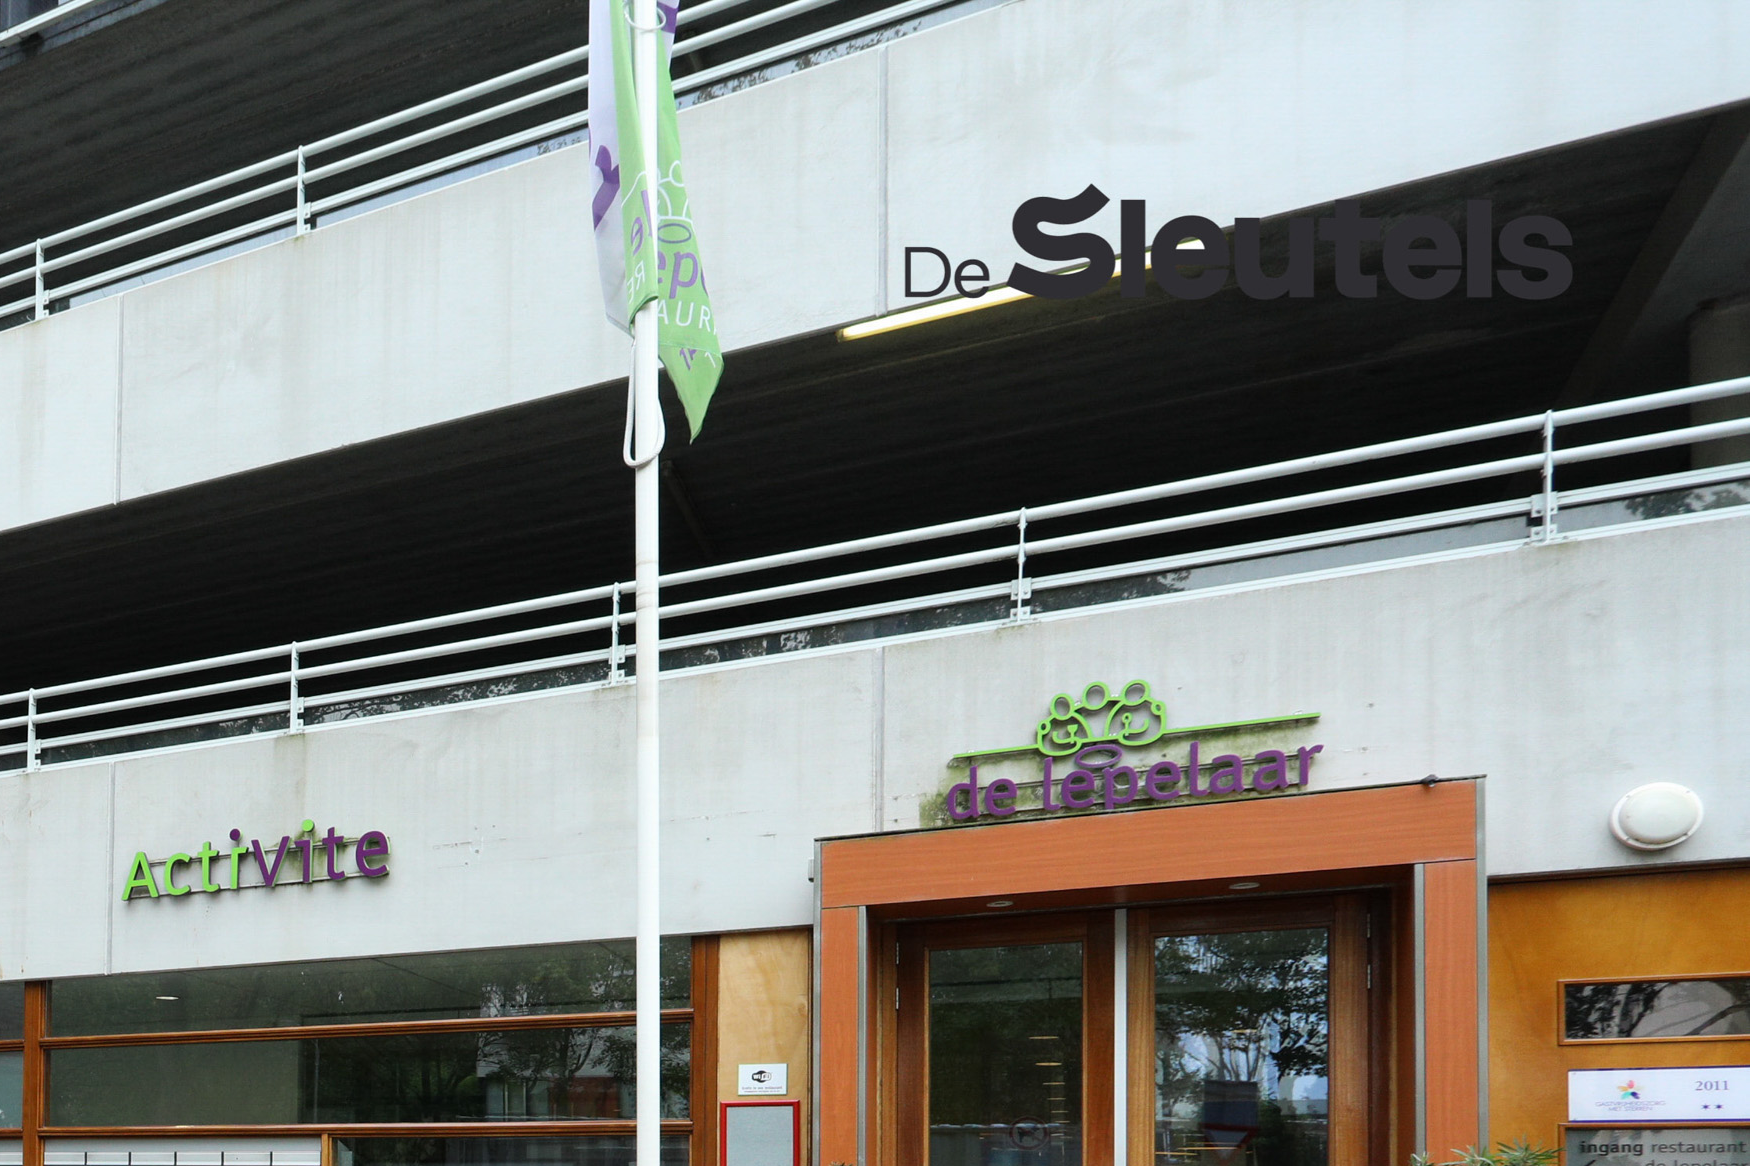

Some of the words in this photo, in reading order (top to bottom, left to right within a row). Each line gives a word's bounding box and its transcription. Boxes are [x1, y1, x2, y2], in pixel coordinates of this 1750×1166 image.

[947, 765, 1018, 820] de
[1043, 740, 1324, 811] lepelaar
[1694, 1080, 1729, 1091] 2011
[1579, 1140, 1643, 1156] ingang
[1651, 1141, 1747, 1154] restaurant
